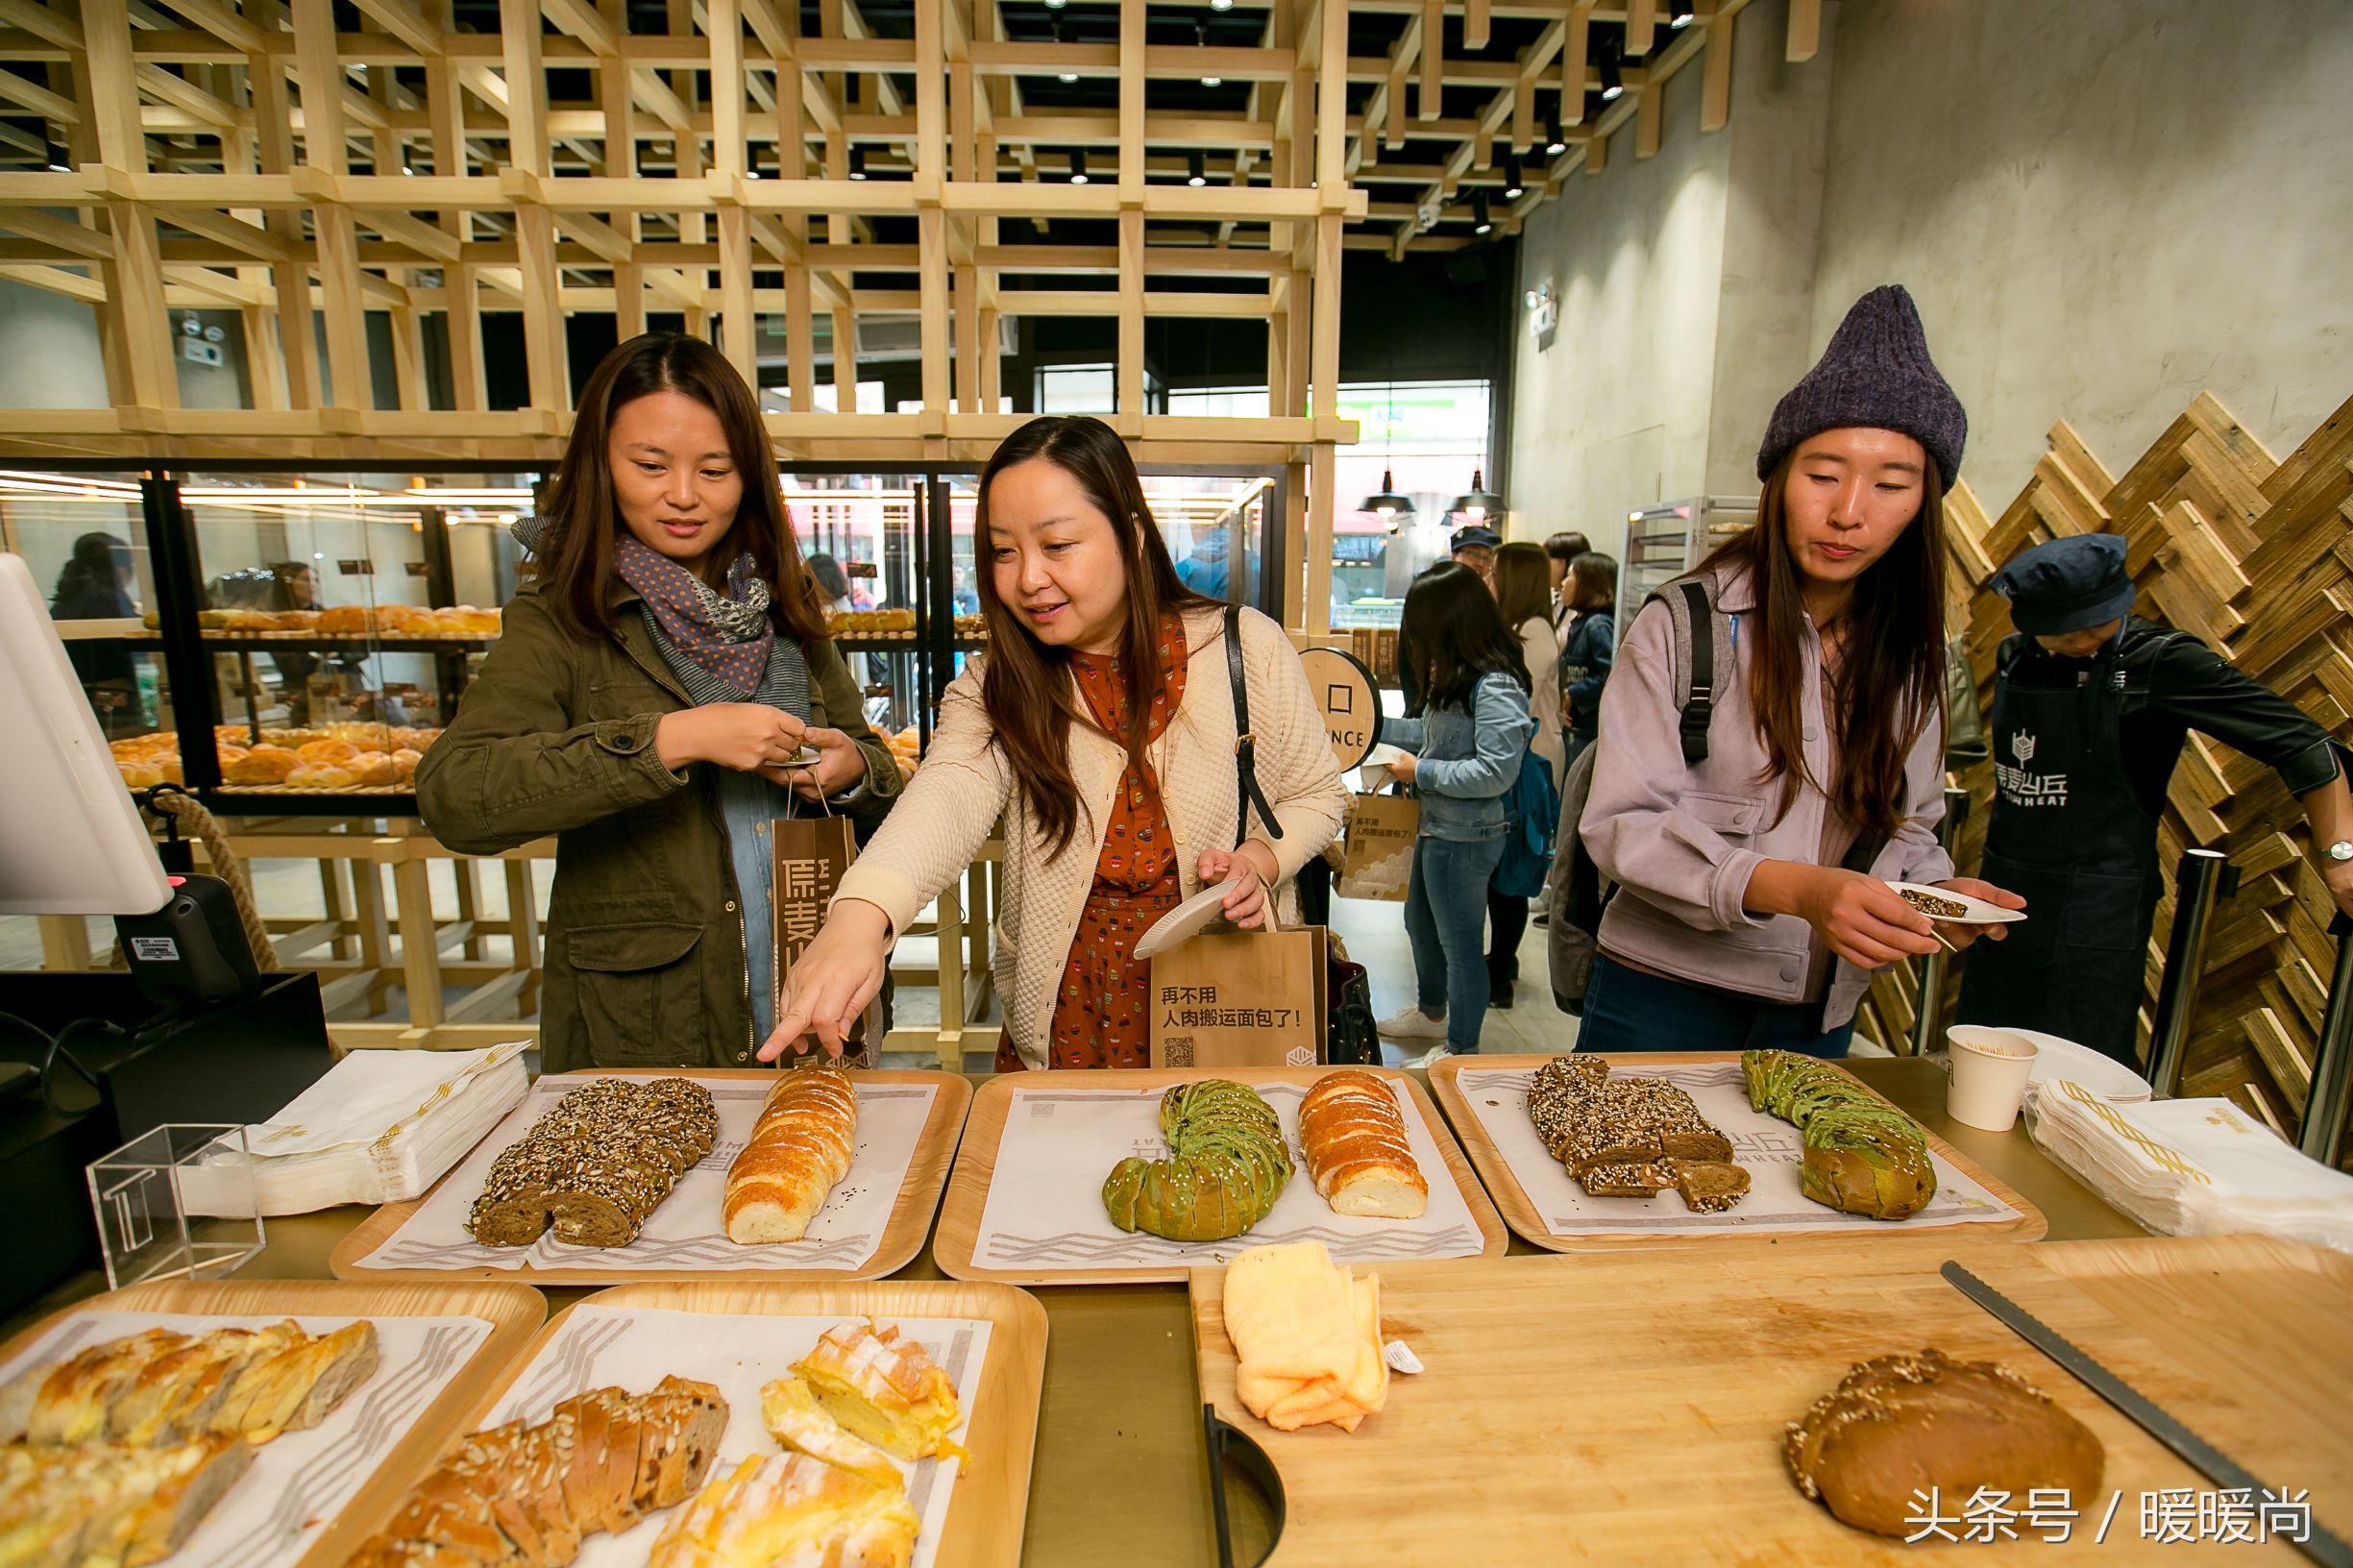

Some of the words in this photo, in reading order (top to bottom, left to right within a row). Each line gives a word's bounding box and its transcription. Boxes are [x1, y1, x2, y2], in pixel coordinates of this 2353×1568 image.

[1332, 730, 1363, 747] NCE
[1162, 987, 1216, 1005] 再不用
[1163, 1009, 1301, 1028] 人肉搬运面包了！
